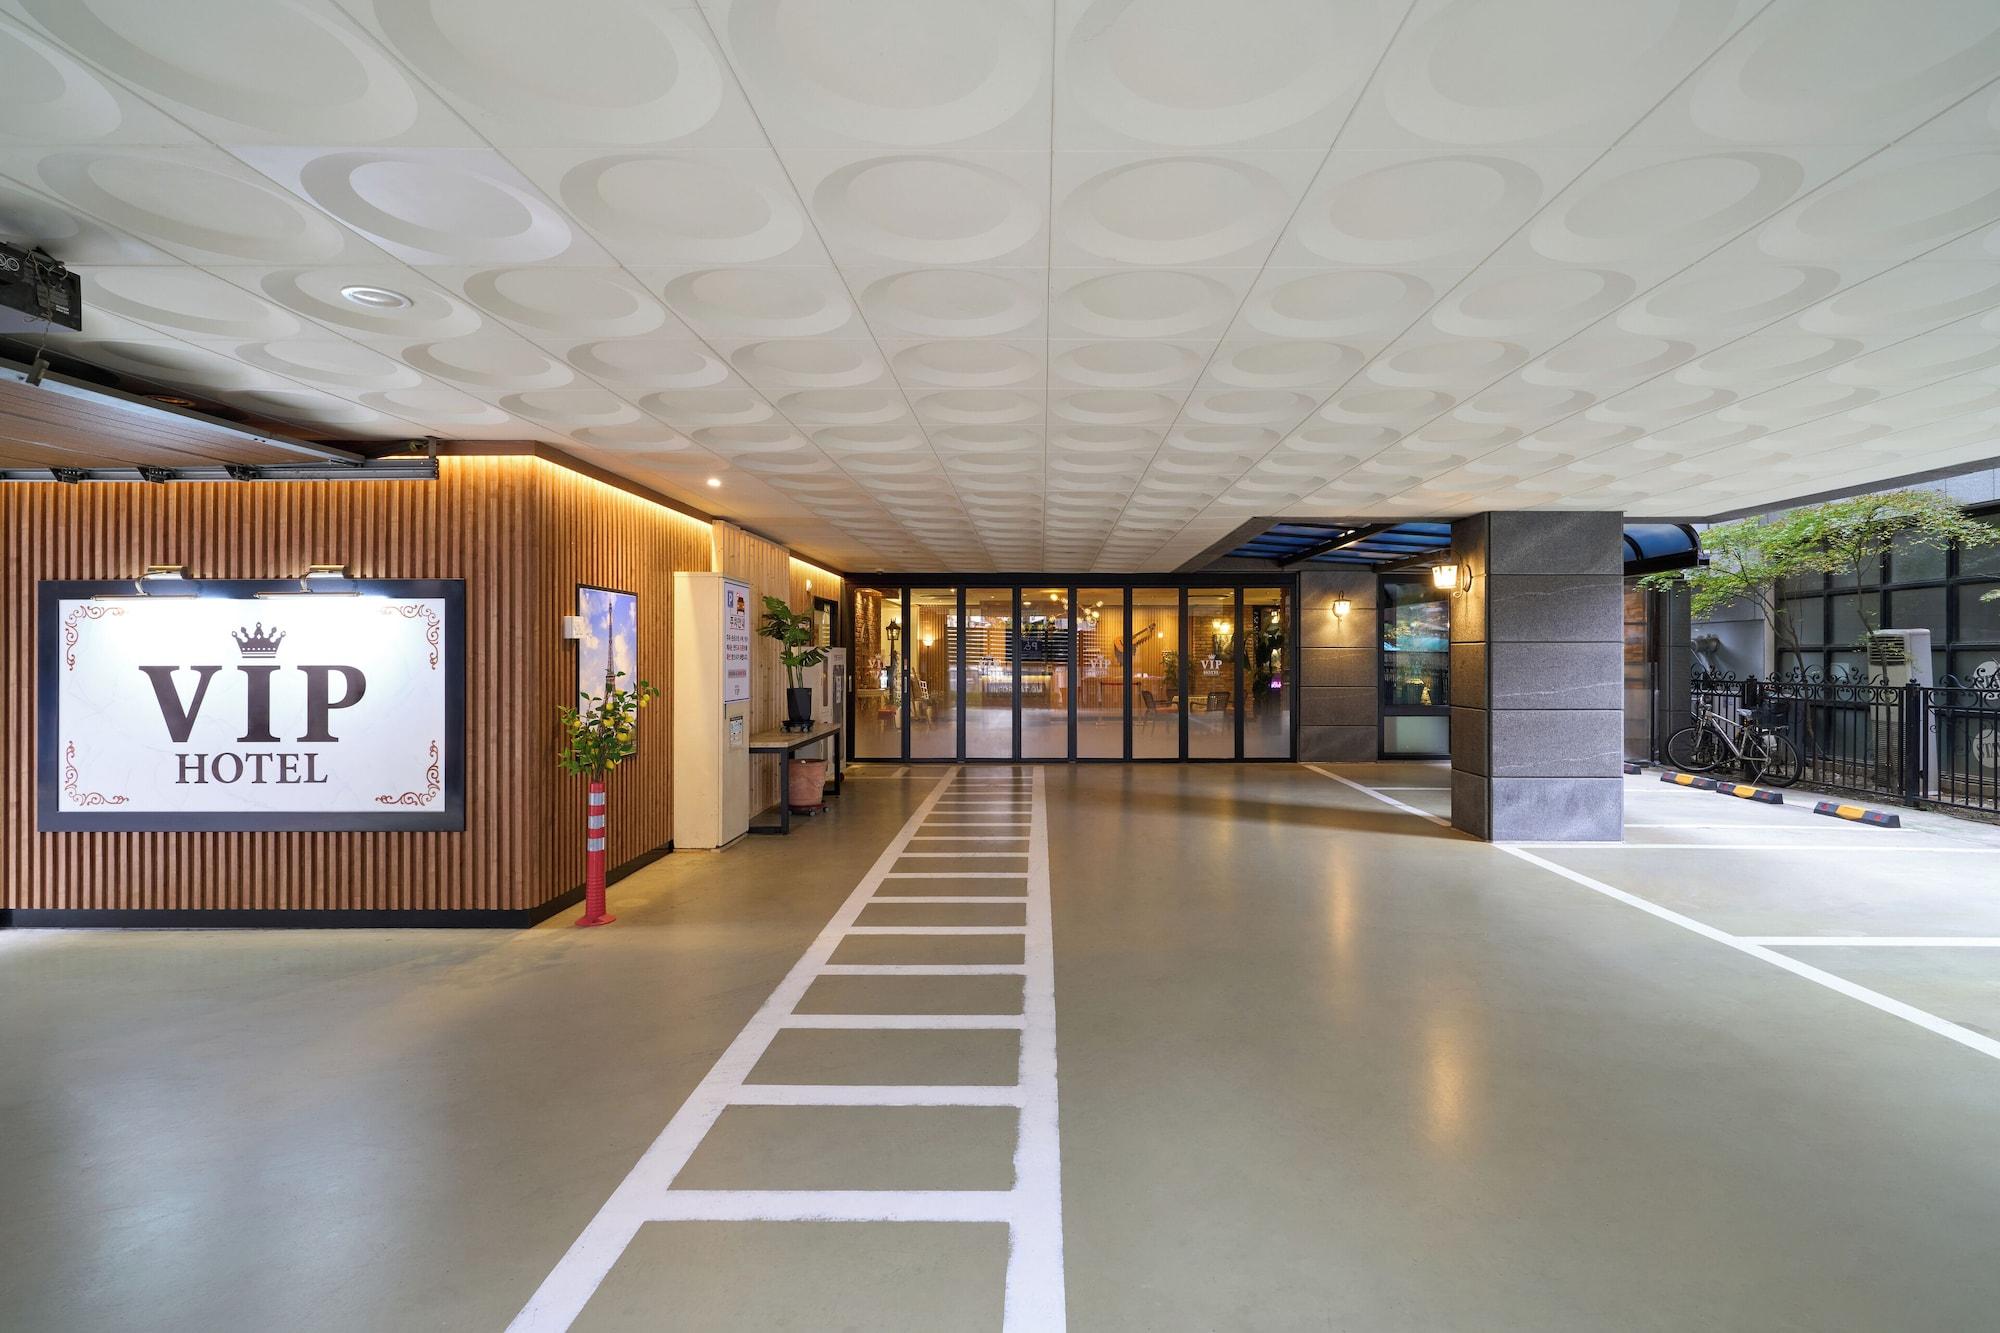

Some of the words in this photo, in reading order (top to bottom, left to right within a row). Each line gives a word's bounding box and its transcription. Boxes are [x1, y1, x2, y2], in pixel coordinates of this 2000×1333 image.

[1200, 659, 1223, 670] VIP
[138, 665, 367, 743] VIP
[175, 752, 328, 784] HOTEL
